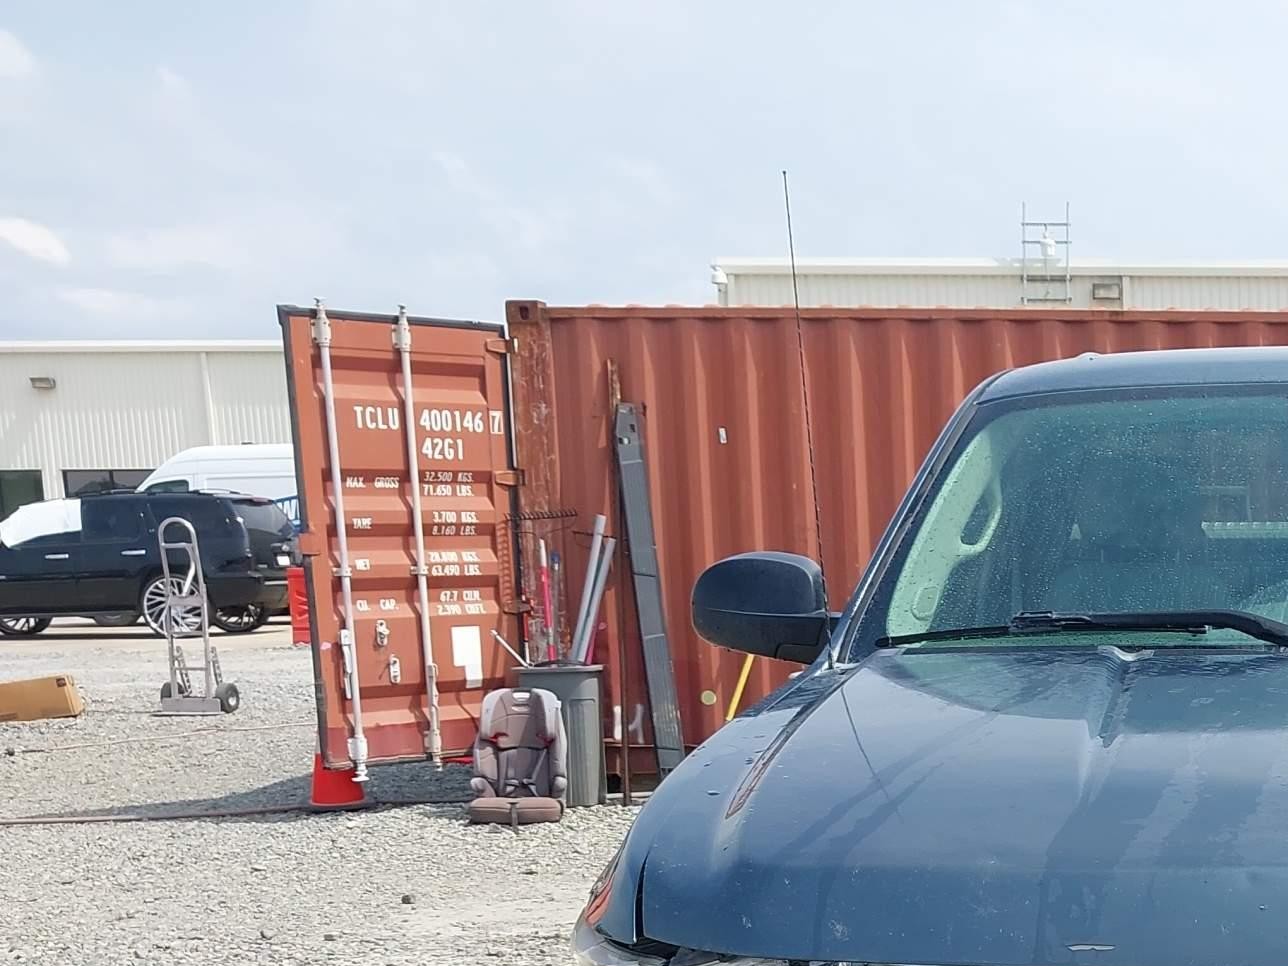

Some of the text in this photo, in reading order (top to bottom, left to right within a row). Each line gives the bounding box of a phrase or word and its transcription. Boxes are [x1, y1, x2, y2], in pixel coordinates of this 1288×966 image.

[353, 406, 399, 430] TCLU
[420, 409, 484, 433] 400146
[422, 437, 464, 460] 42G1
[424, 471, 453, 482] 32.500
[374, 477, 399, 489] GROSS
[457, 484, 474, 496] LBS.
[352, 517, 372, 529] TARE
[432, 511, 457, 523] 3.700
[431, 564, 460, 576] 63.490
[380, 598, 400, 610] CAP.
